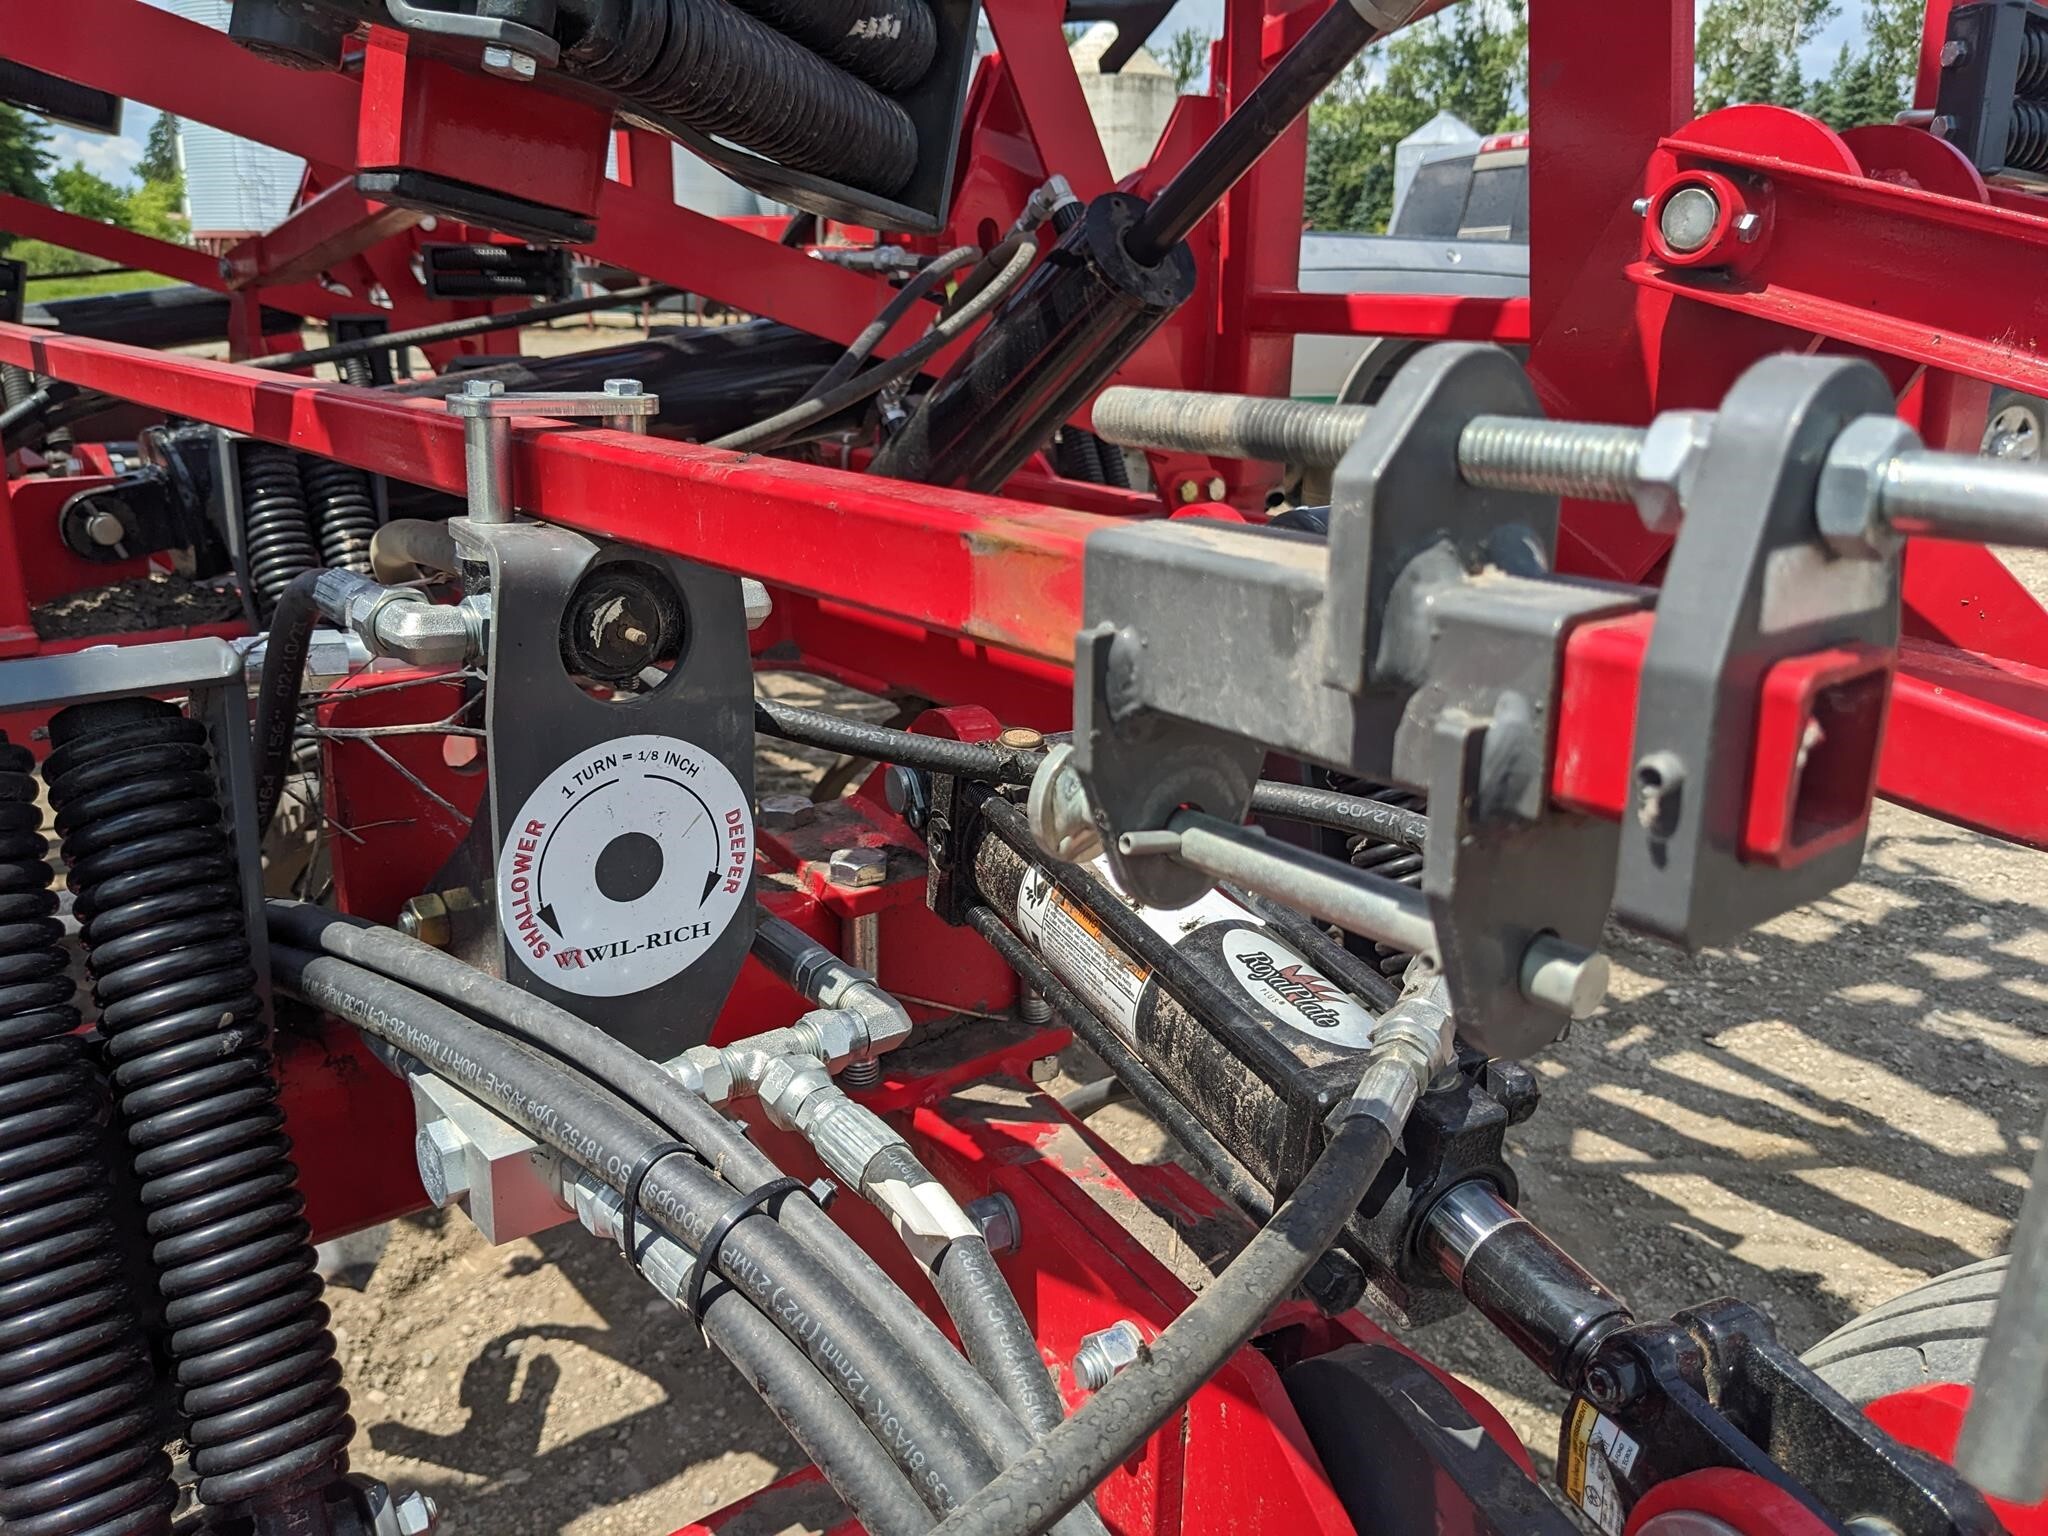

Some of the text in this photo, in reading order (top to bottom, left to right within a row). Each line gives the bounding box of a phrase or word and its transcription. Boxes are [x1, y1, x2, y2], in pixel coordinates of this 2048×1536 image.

[561, 750, 700, 799] 1 TURN = 1/8 INCH
[722, 808, 746, 894] DEEPER
[510, 818, 552, 959] SHALLOWER
[584, 921, 711, 963] WIL-RICH
[406, 1025, 440, 1054] MSHA
[440, 1046, 483, 1082] 100R17
[485, 1072, 527, 1108] A/SAE
[528, 1104, 559, 1136] Type
[560, 1122, 604, 1163] 18752
[820, 1336, 871, 1401] 12mm
